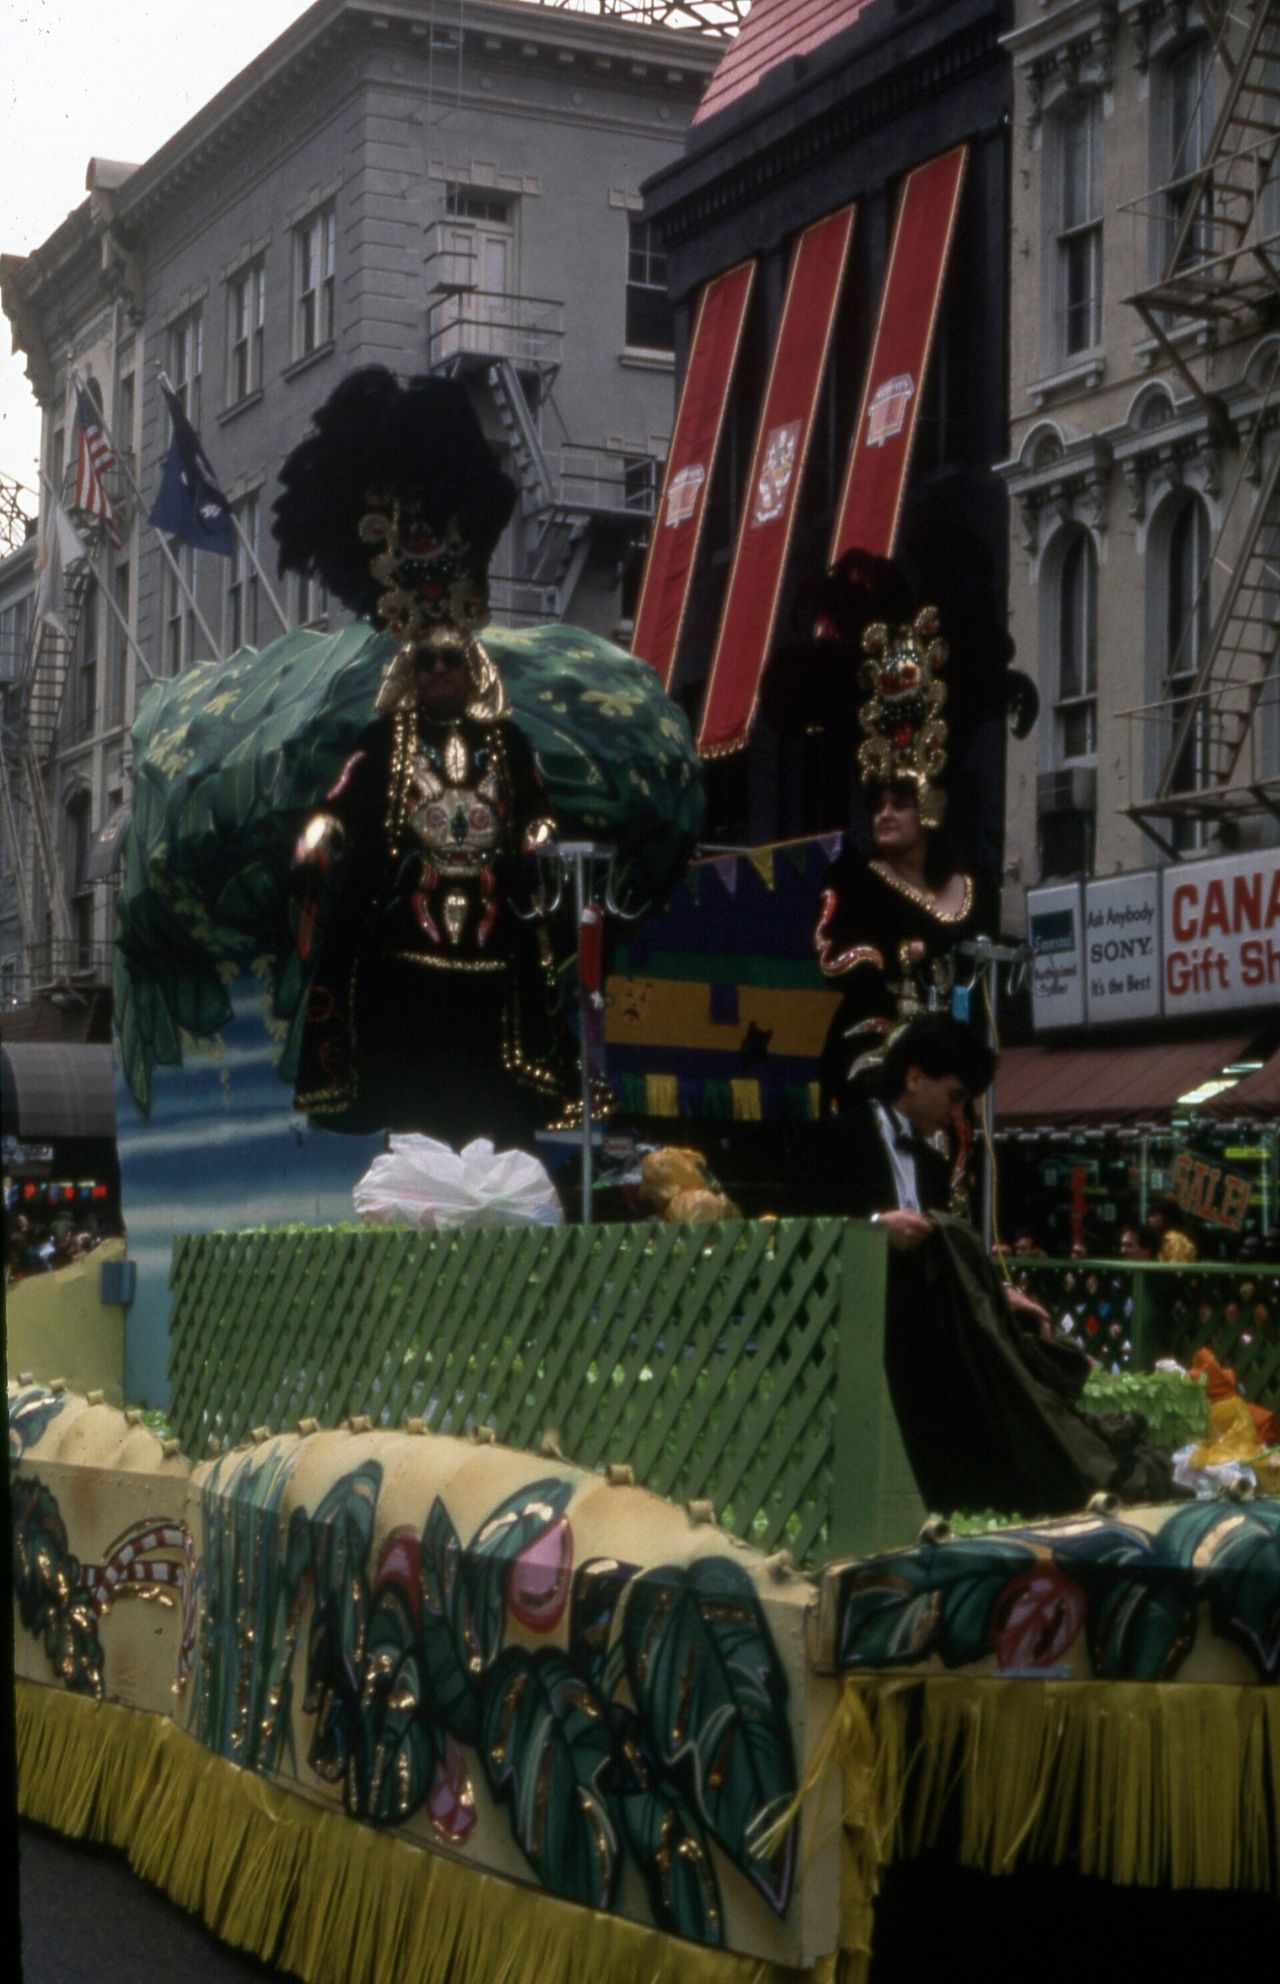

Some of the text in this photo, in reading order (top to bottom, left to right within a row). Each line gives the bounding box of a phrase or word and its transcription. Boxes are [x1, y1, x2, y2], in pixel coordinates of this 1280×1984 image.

[1088, 901, 1154, 928] Ask Anybody
[1090, 937, 1152, 963] SONY
[1167, 946, 1229, 996] Gift
[1091, 974, 1151, 997] It's the Best
